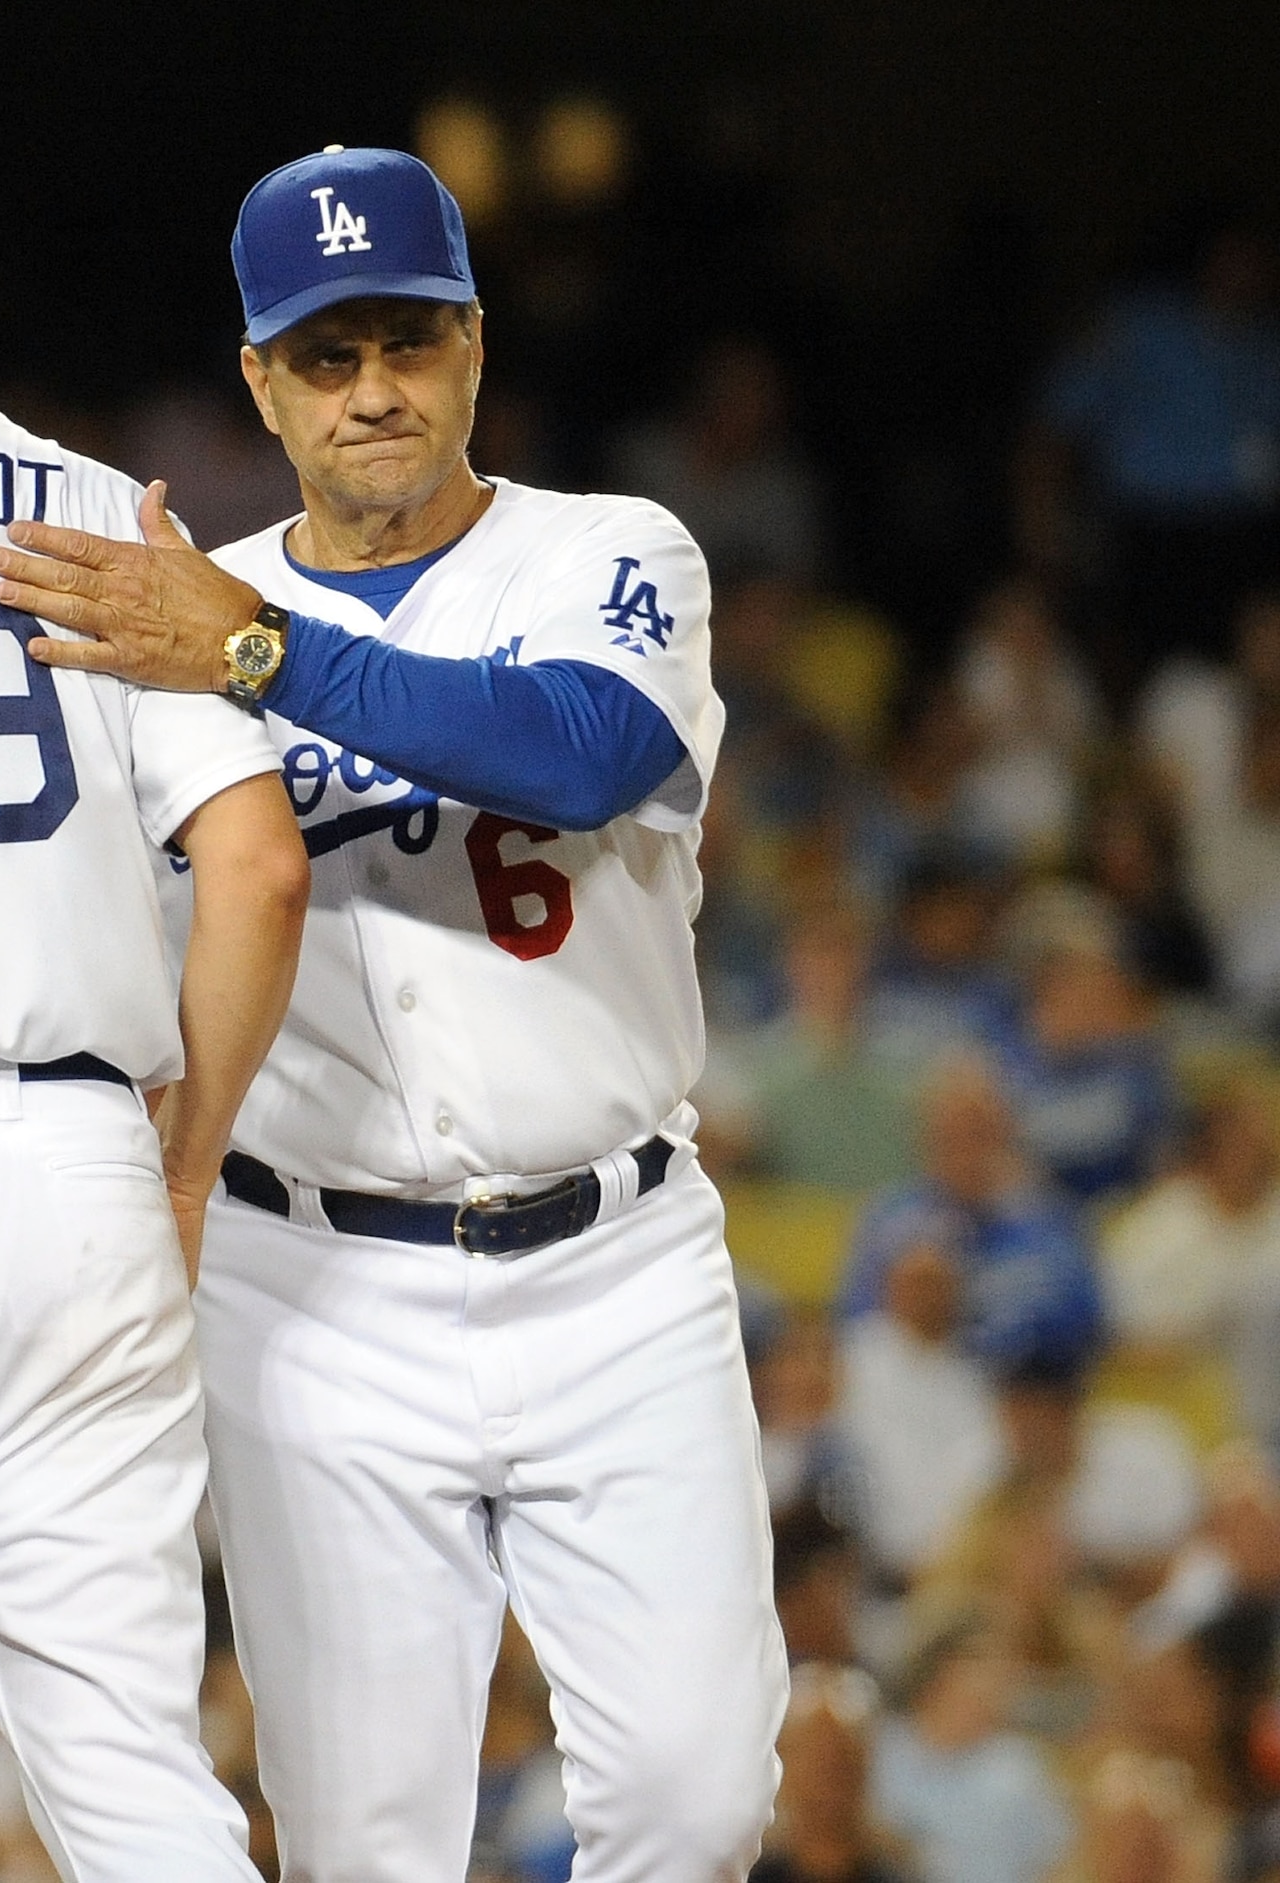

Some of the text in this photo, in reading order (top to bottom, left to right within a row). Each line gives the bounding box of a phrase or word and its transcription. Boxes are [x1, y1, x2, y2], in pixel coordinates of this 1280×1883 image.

[310, 186, 372, 257] LA
[599, 556, 675, 651] LA
[464, 811, 574, 962] 6
